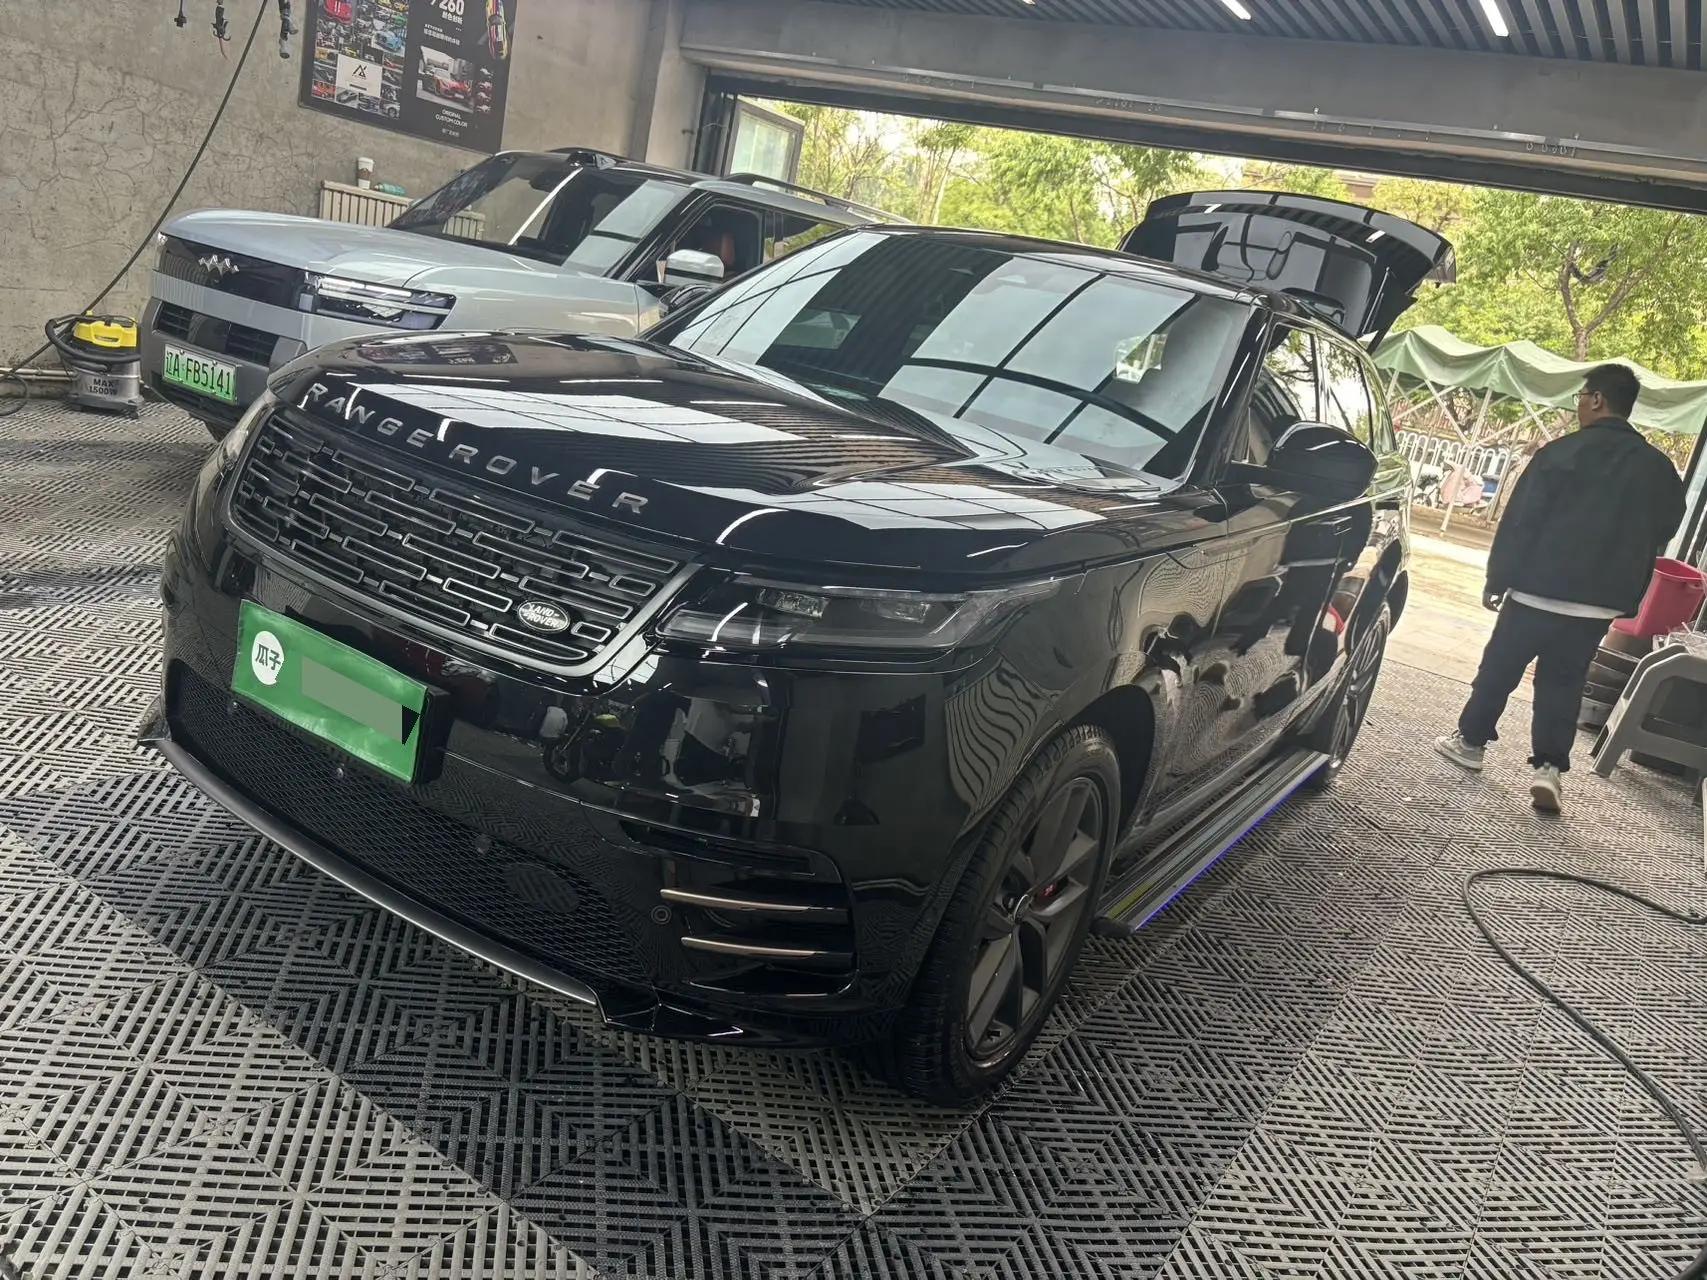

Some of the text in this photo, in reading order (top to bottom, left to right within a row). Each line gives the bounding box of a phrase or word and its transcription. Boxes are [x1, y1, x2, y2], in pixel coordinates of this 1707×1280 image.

[93, 378, 117, 388] MAX
[300, 382, 649, 514] RANGE ROVER
[526, 612, 565, 628] ROVER
